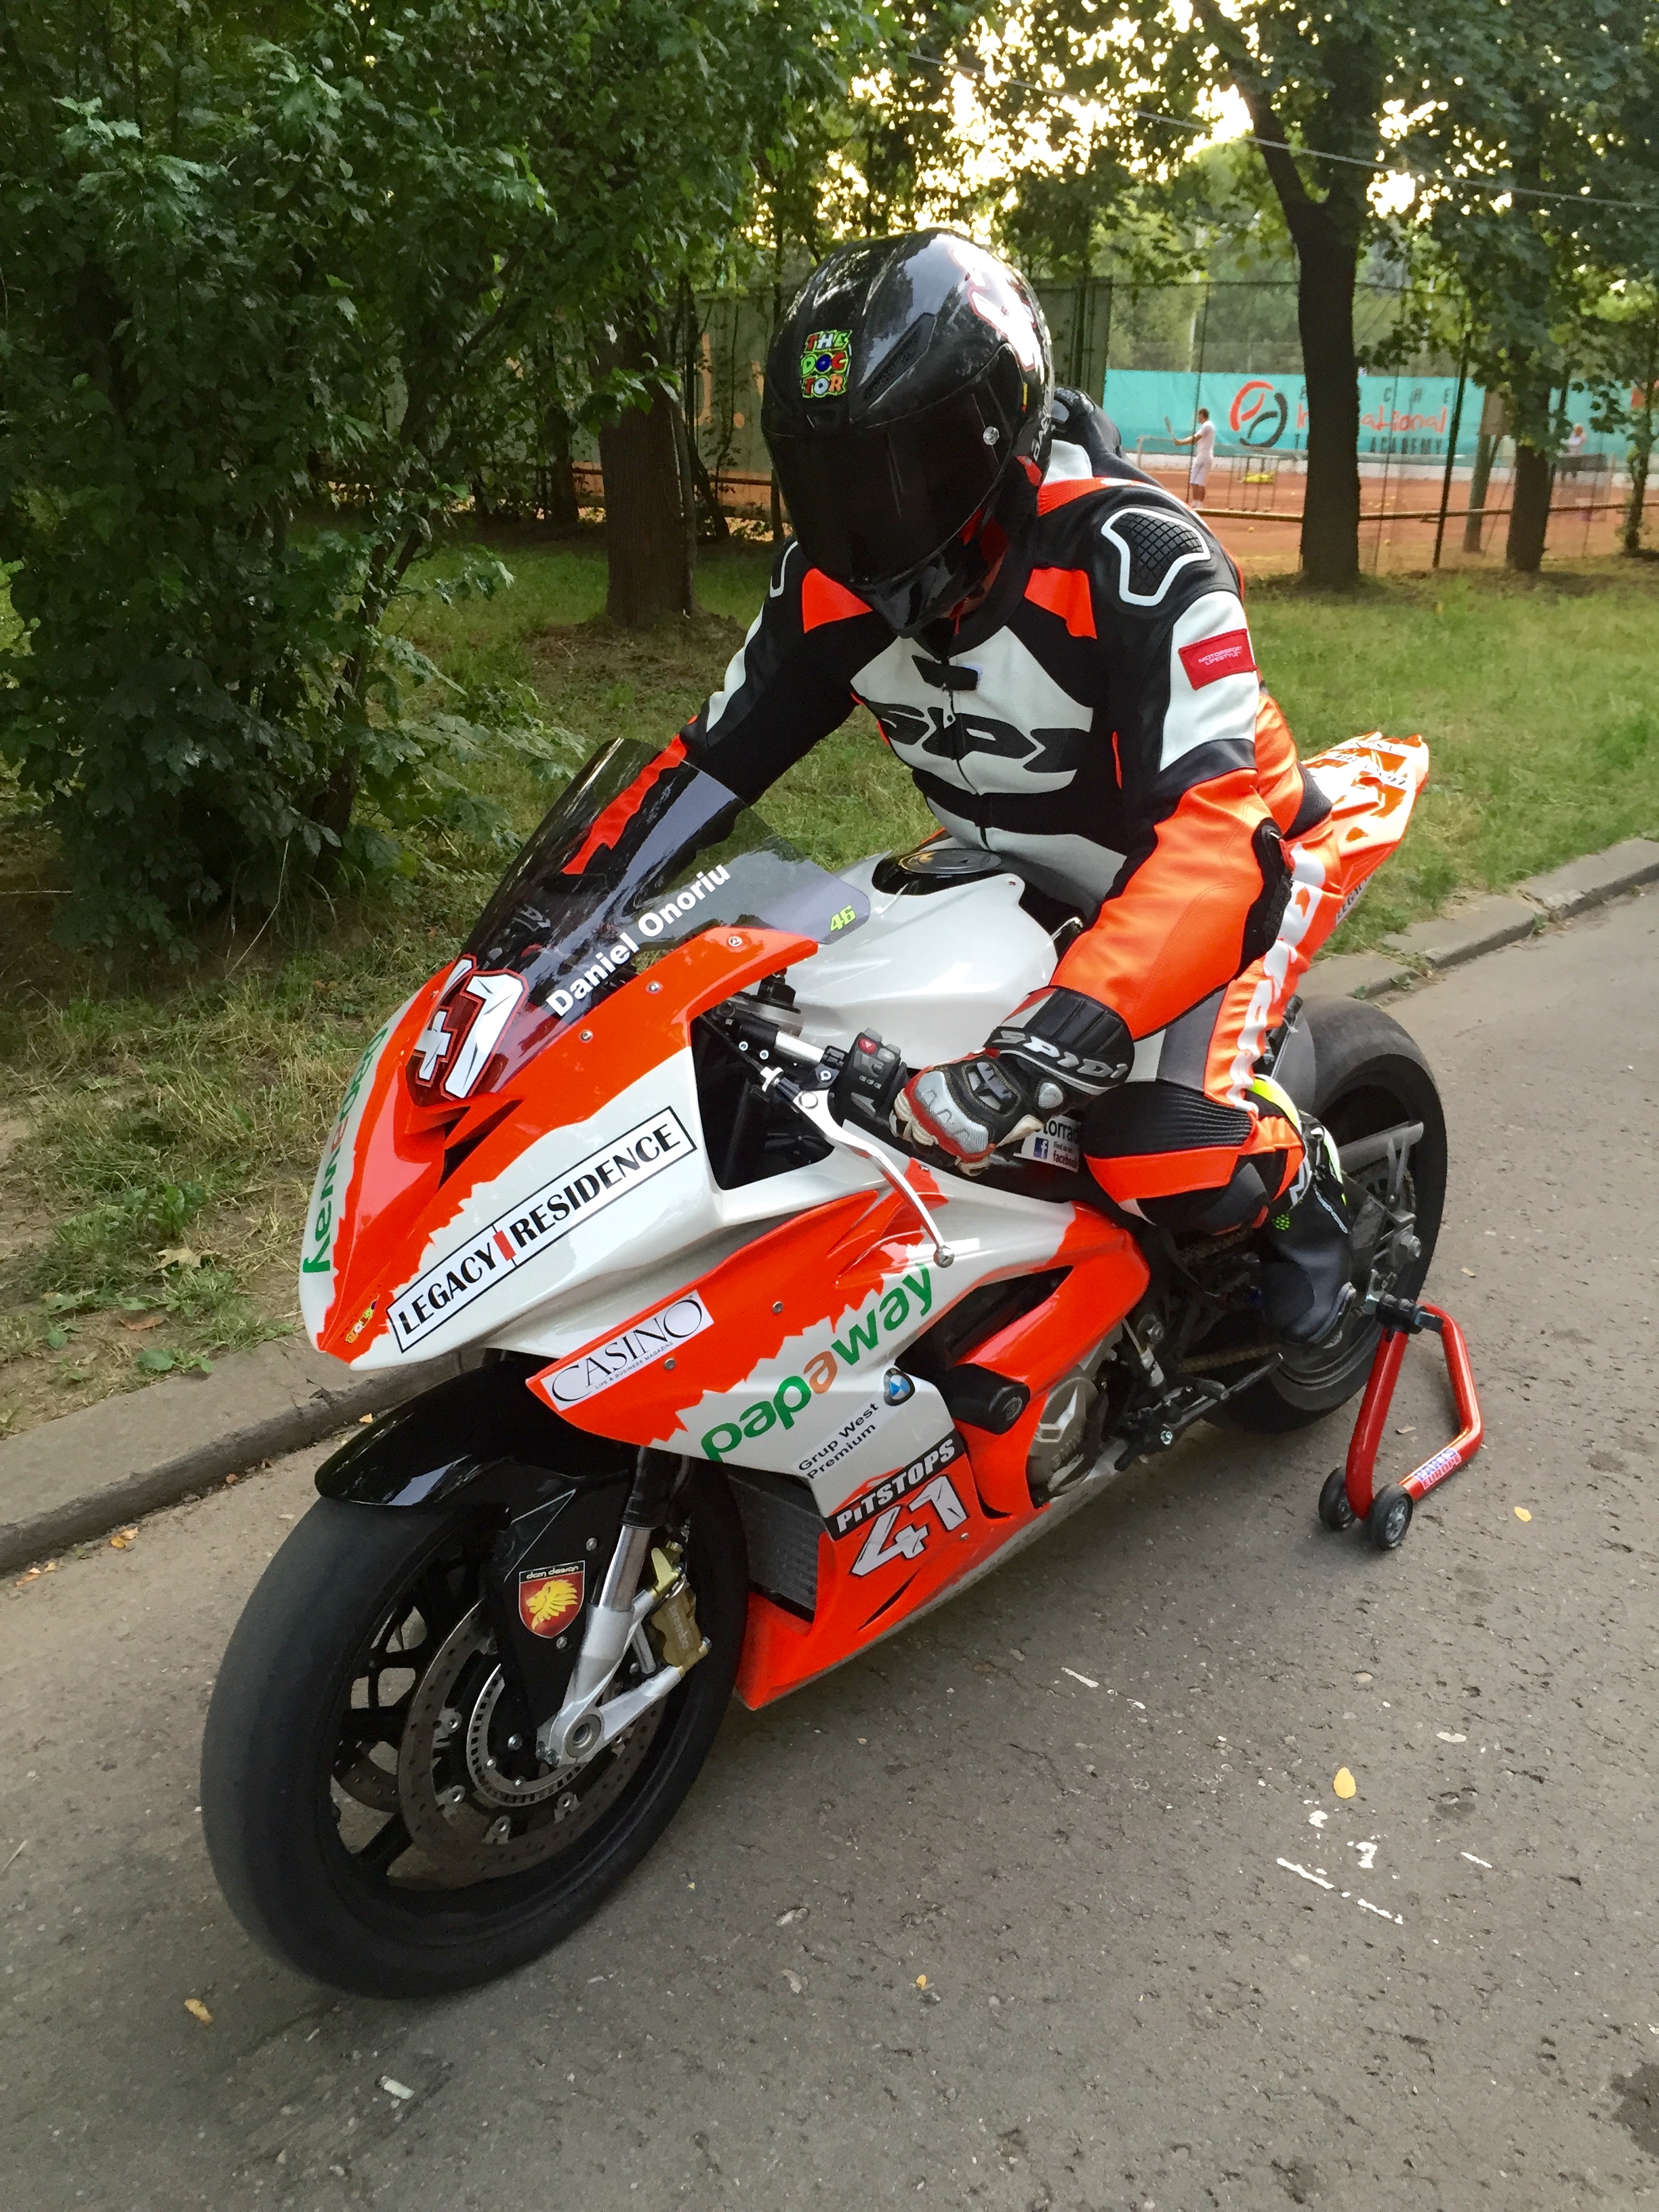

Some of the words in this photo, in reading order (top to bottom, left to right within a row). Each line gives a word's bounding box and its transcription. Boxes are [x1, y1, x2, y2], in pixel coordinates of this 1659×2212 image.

[801, 352, 847, 375] DOC
[806, 331, 851, 350] THE
[802, 375, 846, 396] TOR
[546, 933, 640, 1017] Daniel
[638, 865, 731, 937] Onoriu
[830, 905, 856, 931] 46
[411, 957, 525, 1099] 41
[991, 1030, 1128, 1079] SPIDI
[398, 1242, 495, 1335] LEGACY
[509, 1123, 681, 1249] RESIDENCE
[552, 1299, 703, 1401] CASINO
[595, 1380, 608, 1389] LIFE
[615, 1359, 644, 1378] BUSINESS
[644, 1340, 674, 1361] MAGAZINE
[701, 1263, 933, 1462] papaway
[798, 1440, 838, 1471] Grup
[838, 1402, 879, 1438] West
[806, 1424, 876, 1479] Premium
[1423, 1455, 1462, 1490] EUROPE
[851, 1475, 968, 1576] 41
